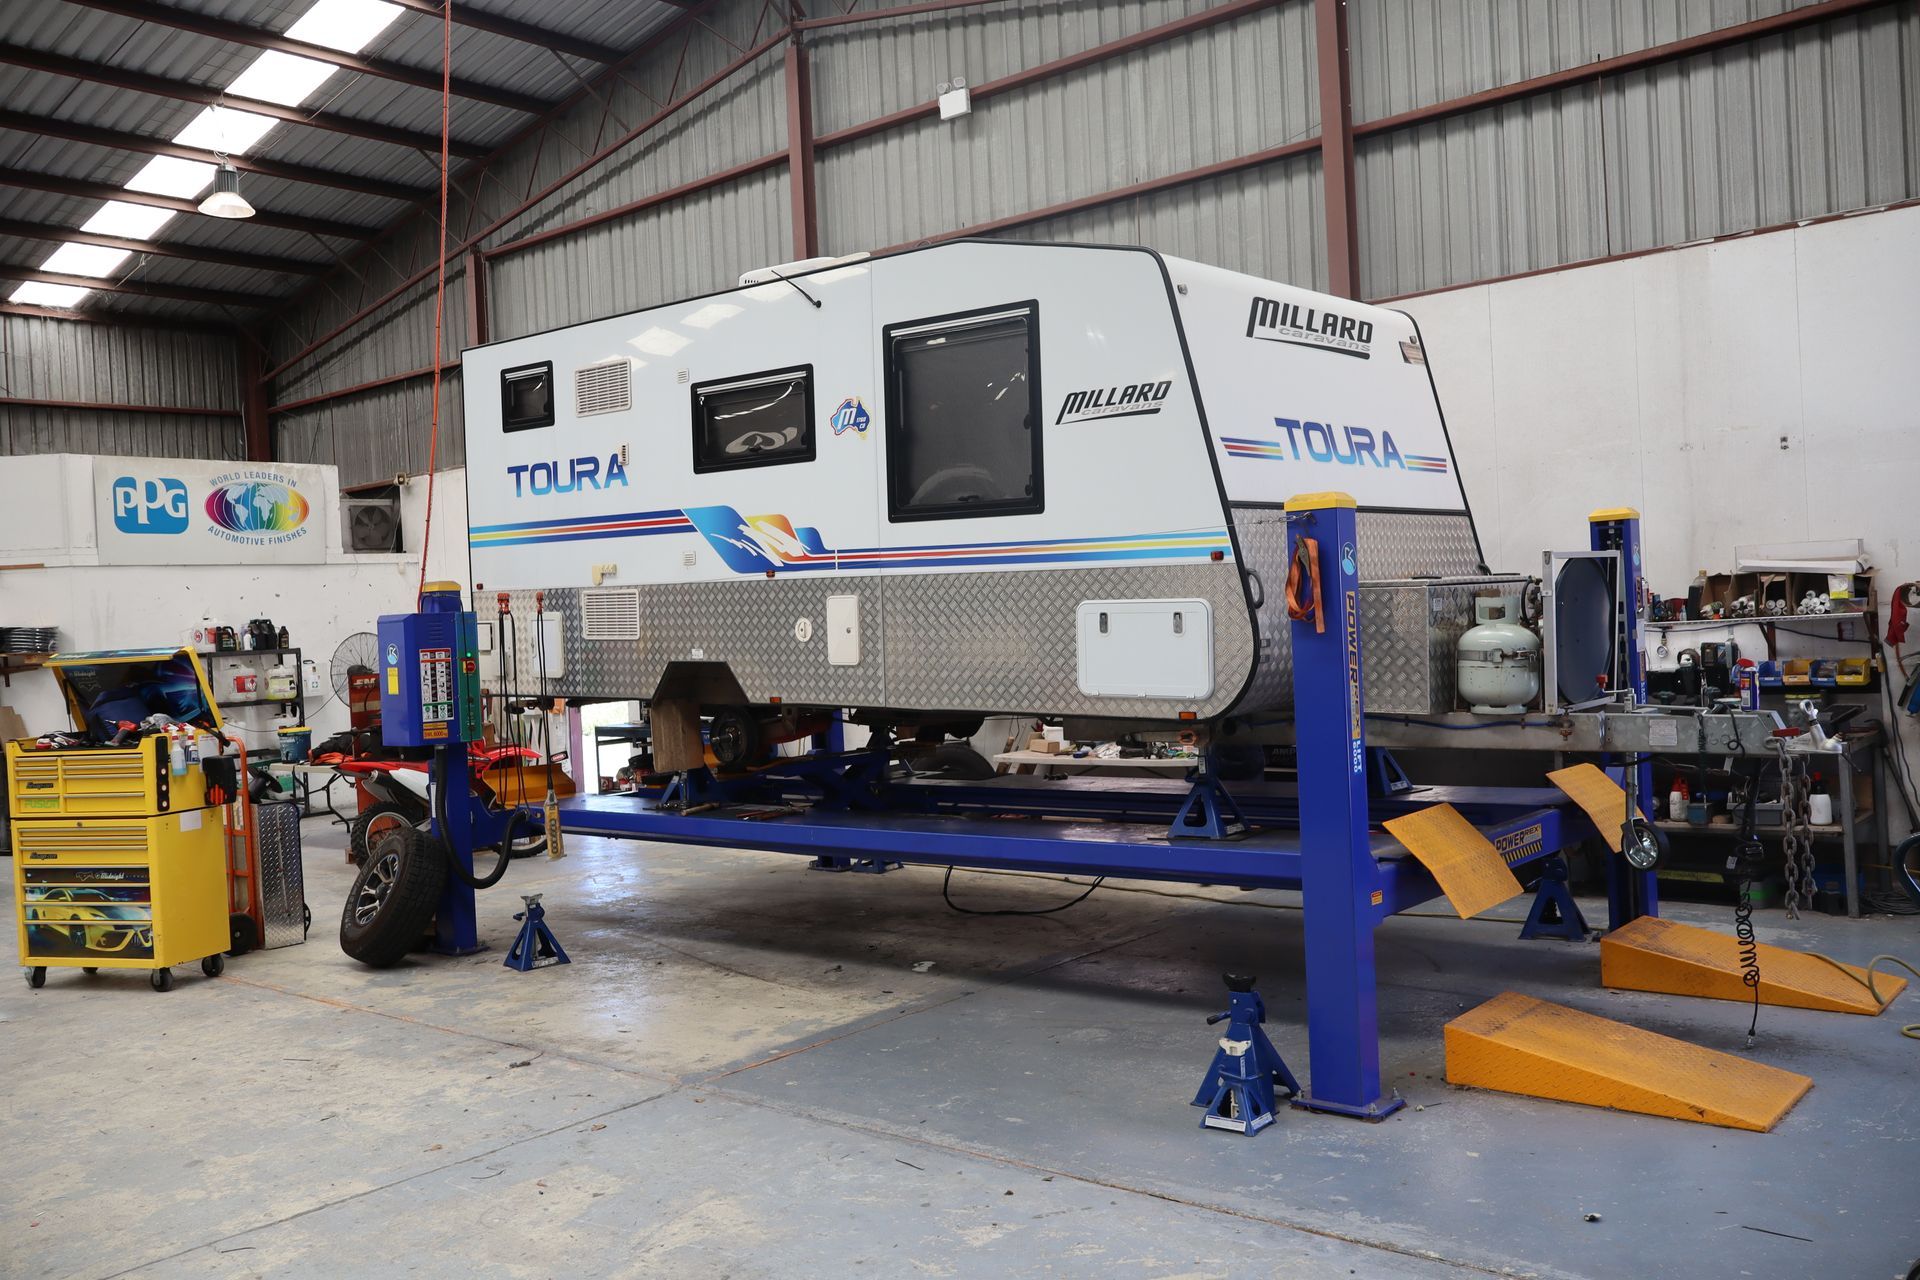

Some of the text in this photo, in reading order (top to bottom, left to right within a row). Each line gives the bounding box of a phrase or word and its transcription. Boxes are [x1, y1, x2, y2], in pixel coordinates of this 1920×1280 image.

[1246, 296, 1373, 344] MILLARD
[1278, 326, 1371, 352] caravans
[1055, 380, 1172, 425] MILLARD
[1081, 401, 1164, 416] caravans
[1274, 417, 1406, 469] TOURA
[209, 471, 298, 488] WORLD LEADERS IN
[507, 453, 629, 498] TOURA
[115, 477, 187, 525] PPG
[207, 525, 308, 546] AUTOMOTIVE FINISHES
